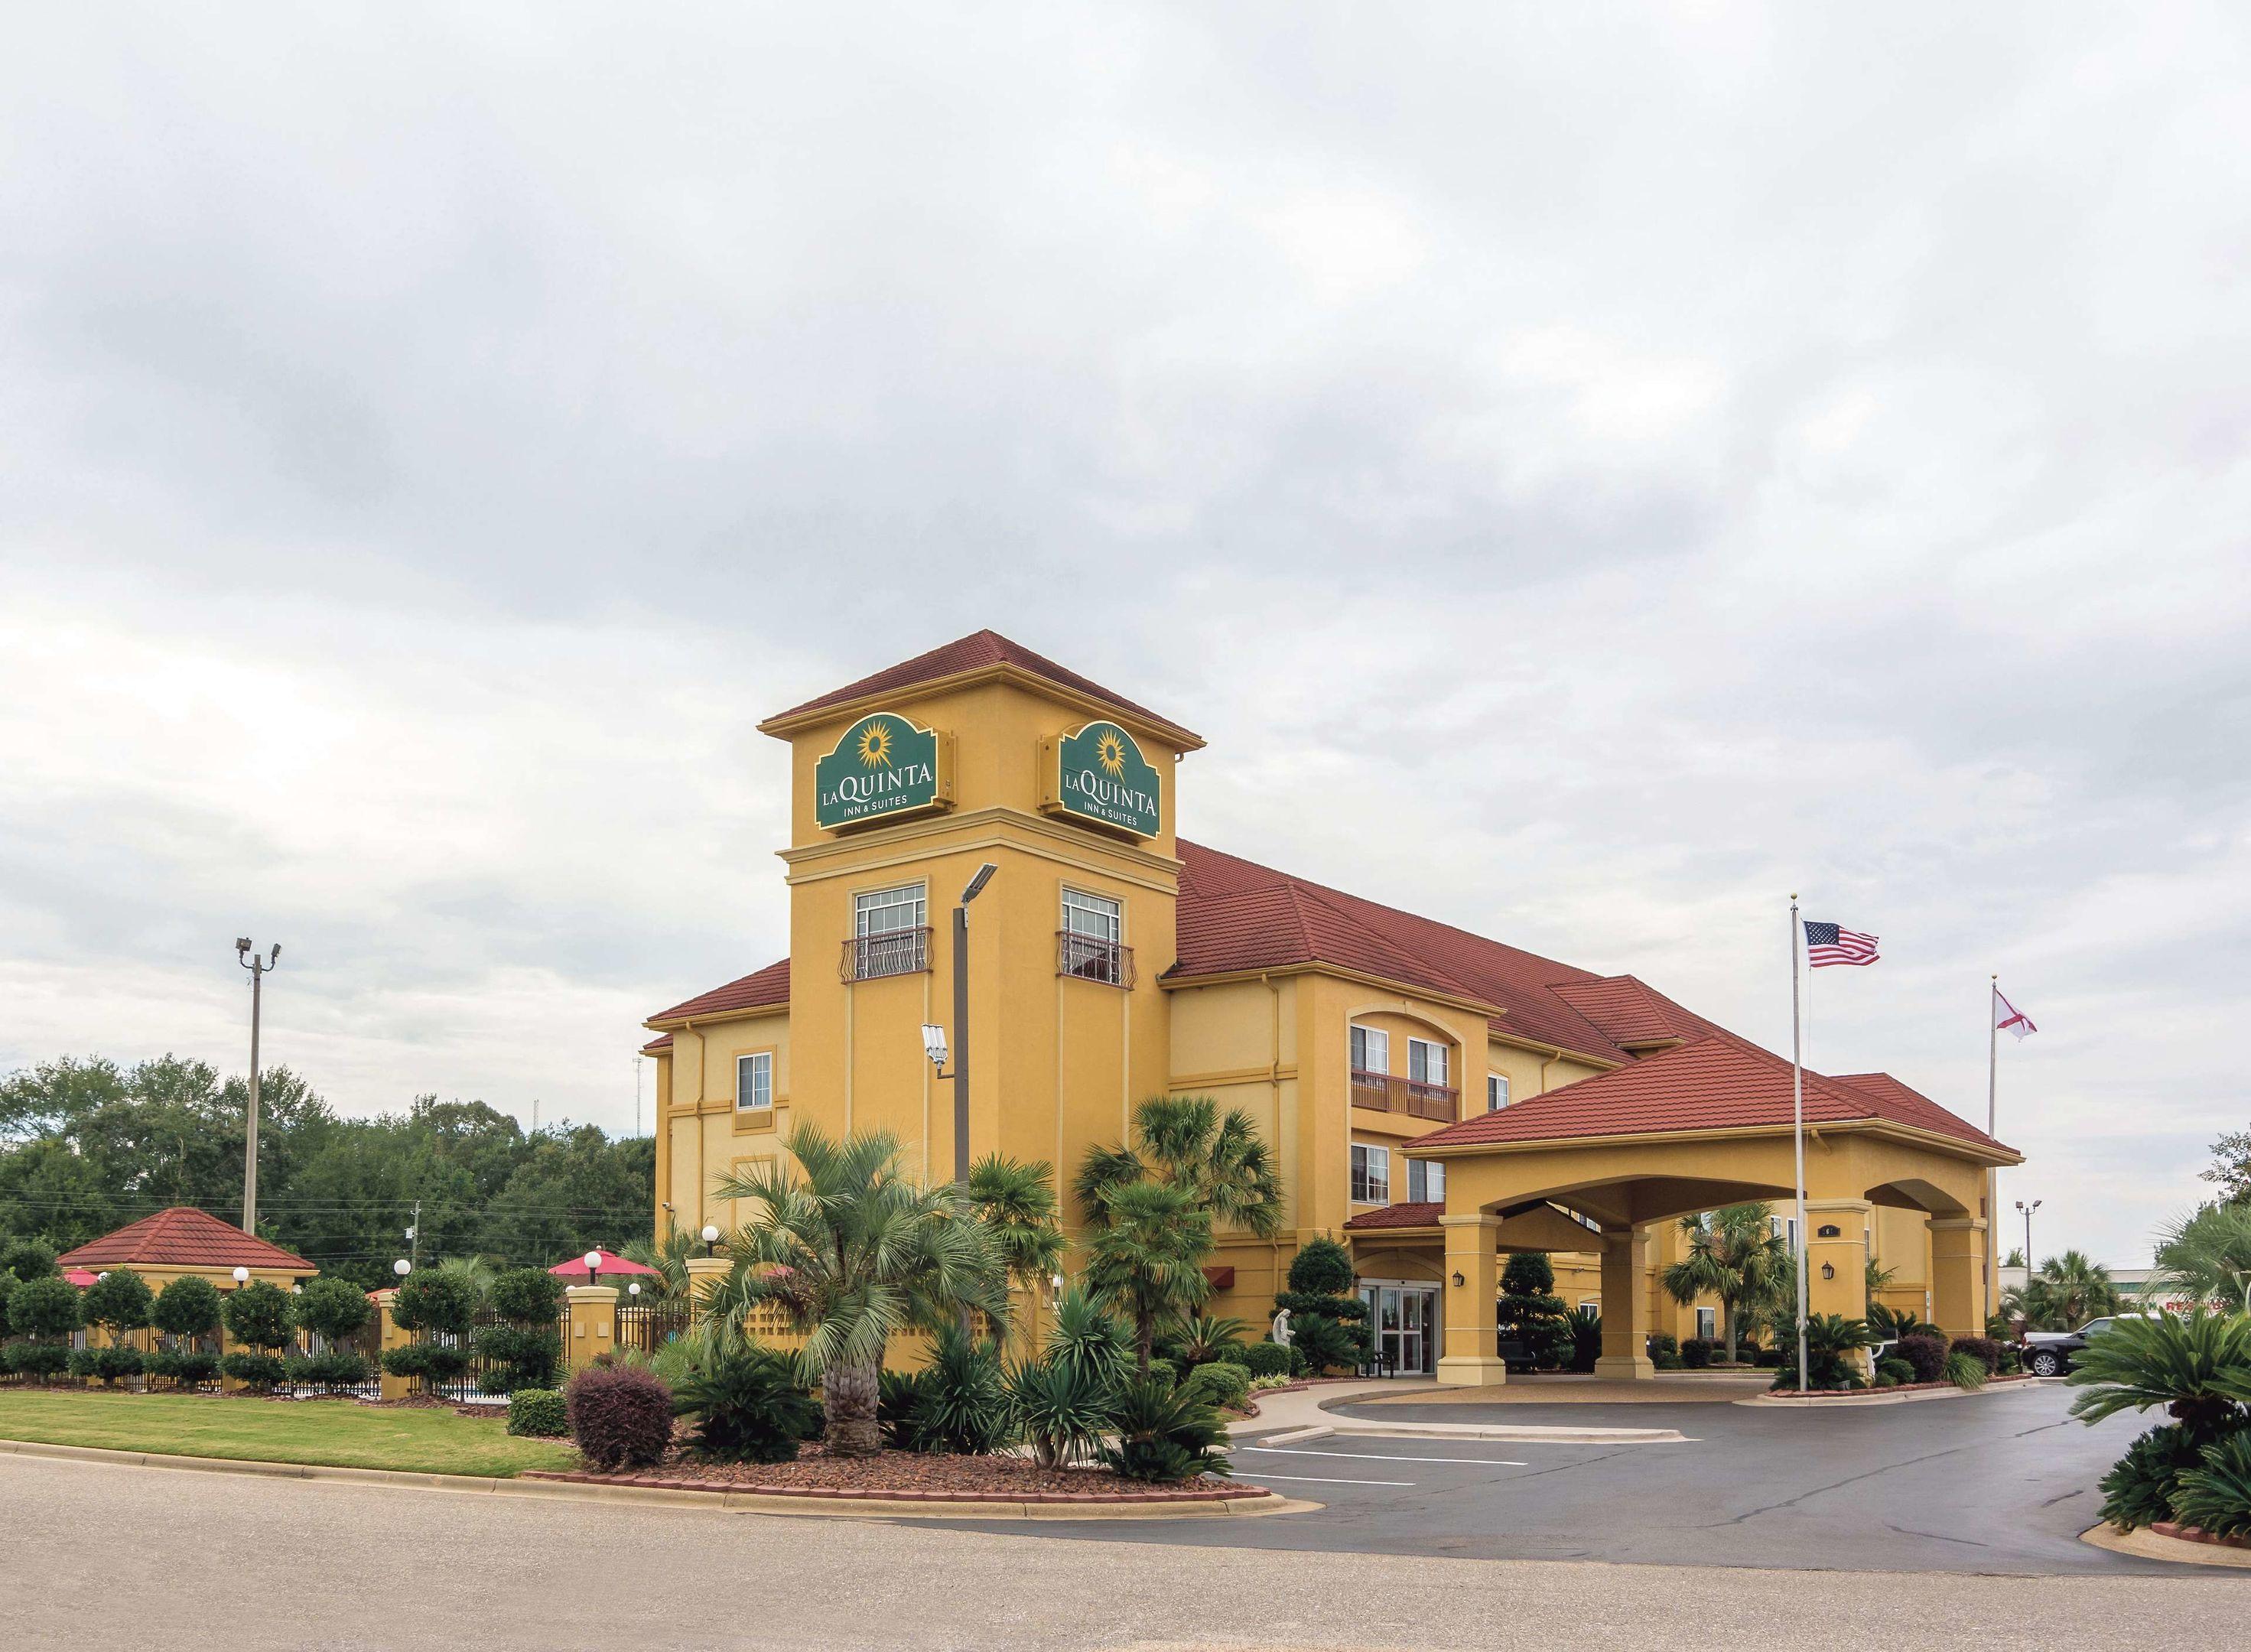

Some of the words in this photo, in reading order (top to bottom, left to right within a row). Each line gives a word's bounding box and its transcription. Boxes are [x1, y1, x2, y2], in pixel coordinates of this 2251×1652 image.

[823, 791, 838, 805] LA
[839, 762, 932, 803] QUINTA
[1065, 774, 1079, 792] LA
[1080, 769, 1156, 817] QUINTA
[844, 805, 861, 817] INN
[871, 794, 908, 811] SUITES
[1084, 801, 1099, 815] INN
[1101, 808, 1106, 816] &
[1108, 808, 1138, 827] SUITES
